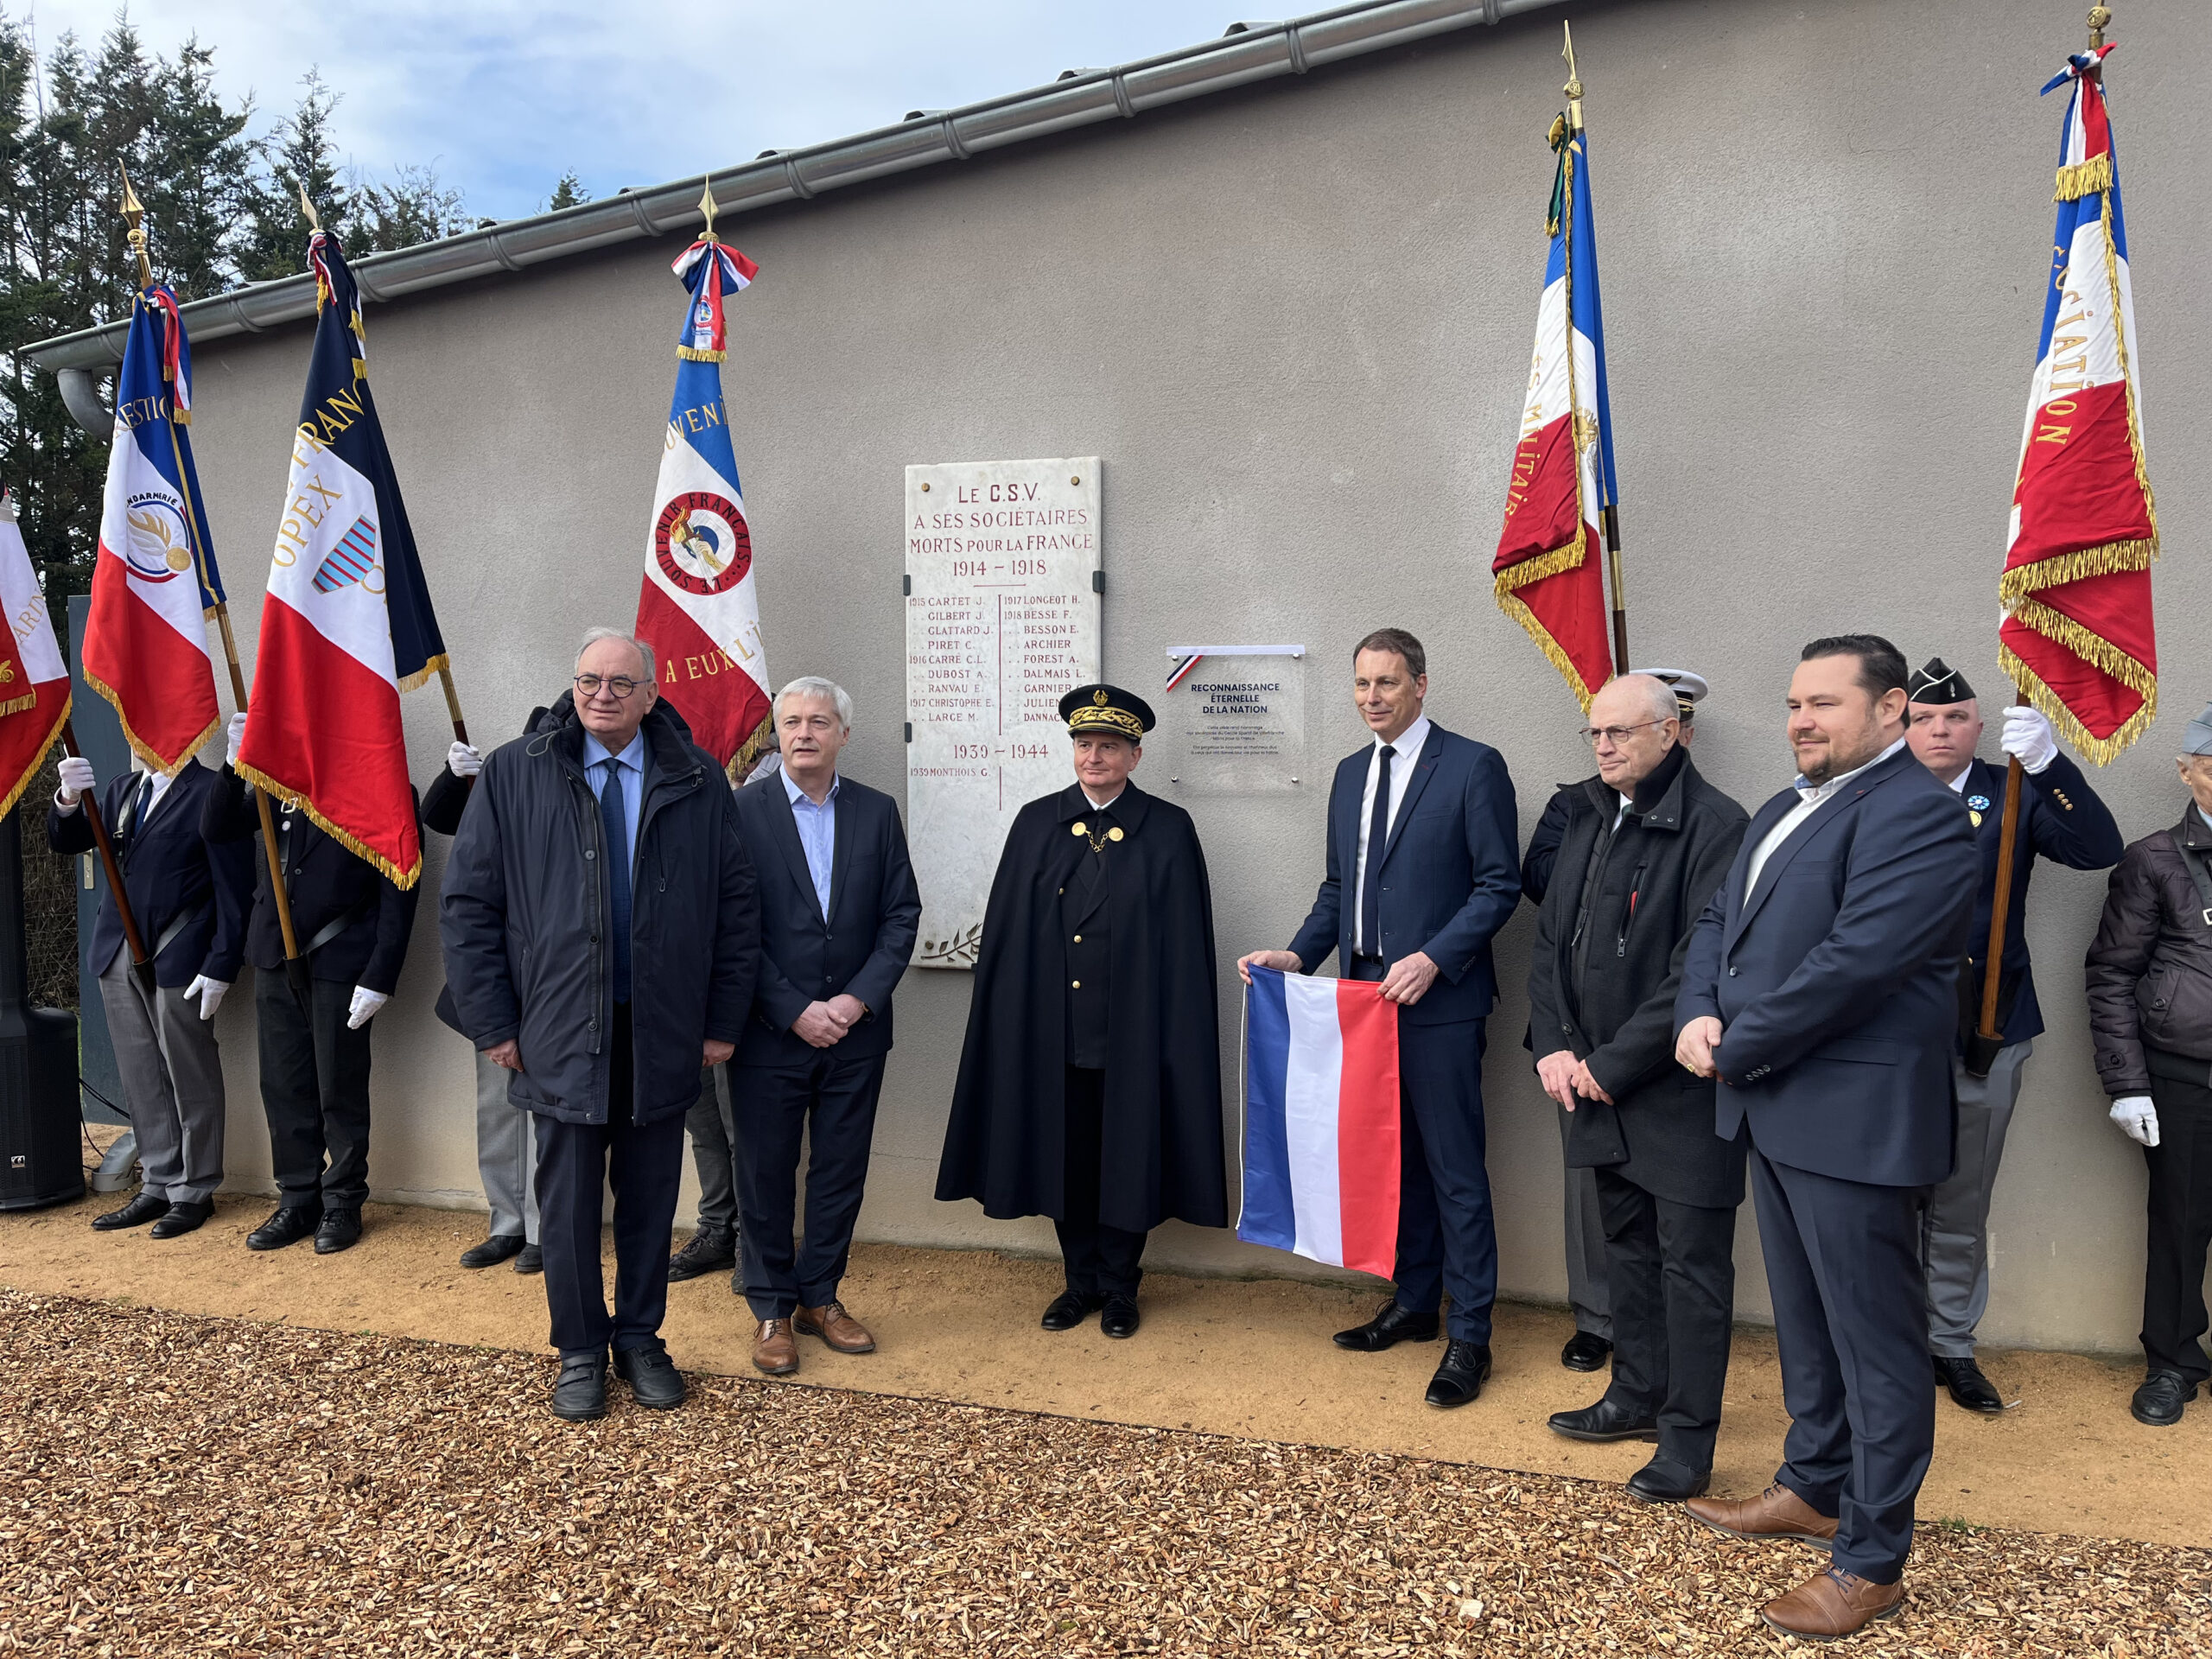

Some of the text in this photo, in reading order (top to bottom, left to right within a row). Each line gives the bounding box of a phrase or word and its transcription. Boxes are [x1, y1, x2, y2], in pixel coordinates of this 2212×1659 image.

[958, 483, 1041, 503] LE C.S.V.
[126, 492, 178, 508] NDARMERIE
[273, 474, 343, 568] OPEX
[914, 515, 925, 530] A
[933, 513, 963, 529] SES
[656, 501, 692, 588] SOUVENIR
[910, 534, 1093, 553] MORTS POUR LA FRANCE
[953, 562, 987, 576] 1914
[1012, 559, 1047, 575] 1918
[909, 597, 925, 607] 1915
[928, 596, 971, 606] CARTET
[1004, 596, 1022, 605] 1917
[1023, 595, 1066, 605] LONGEOT
[928, 611, 971, 620] GILBERT
[1004, 610, 1022, 620] 1918
[1023, 610, 1058, 620] BESSE
[928, 626, 980, 635] GLATTARD
[1024, 625, 1079, 634] BESSON E.
[928, 640, 960, 650] PIRET
[1023, 639, 1071, 649] ARCHIER
[664, 659, 678, 683] A
[683, 645, 735, 680] EUX
[909, 655, 927, 664] 1916
[1023, 654, 1079, 664] FOREST A.
[928, 670, 971, 678] DUBOST
[1023, 669, 1086, 678] DALMAIS L.
[928, 683, 968, 693] RANVAU
[1024, 683, 1071, 693] GARNIER
[1191, 683, 1280, 692] RECONNAISSANCE
[1211, 693, 1260, 702] ÉTERNELLE
[910, 698, 926, 708] 1917
[928, 698, 982, 708] CHRISTOPHE
[1230, 705, 1268, 714] NATION
[928, 713, 963, 722] LARGE
[1024, 713, 1063, 722] DANNAC
[954, 745, 988, 760] 1939
[1011, 744, 1049, 759] 1944
[910, 767, 929, 777] 1939
[930, 767, 976, 777] MONTHOIS
